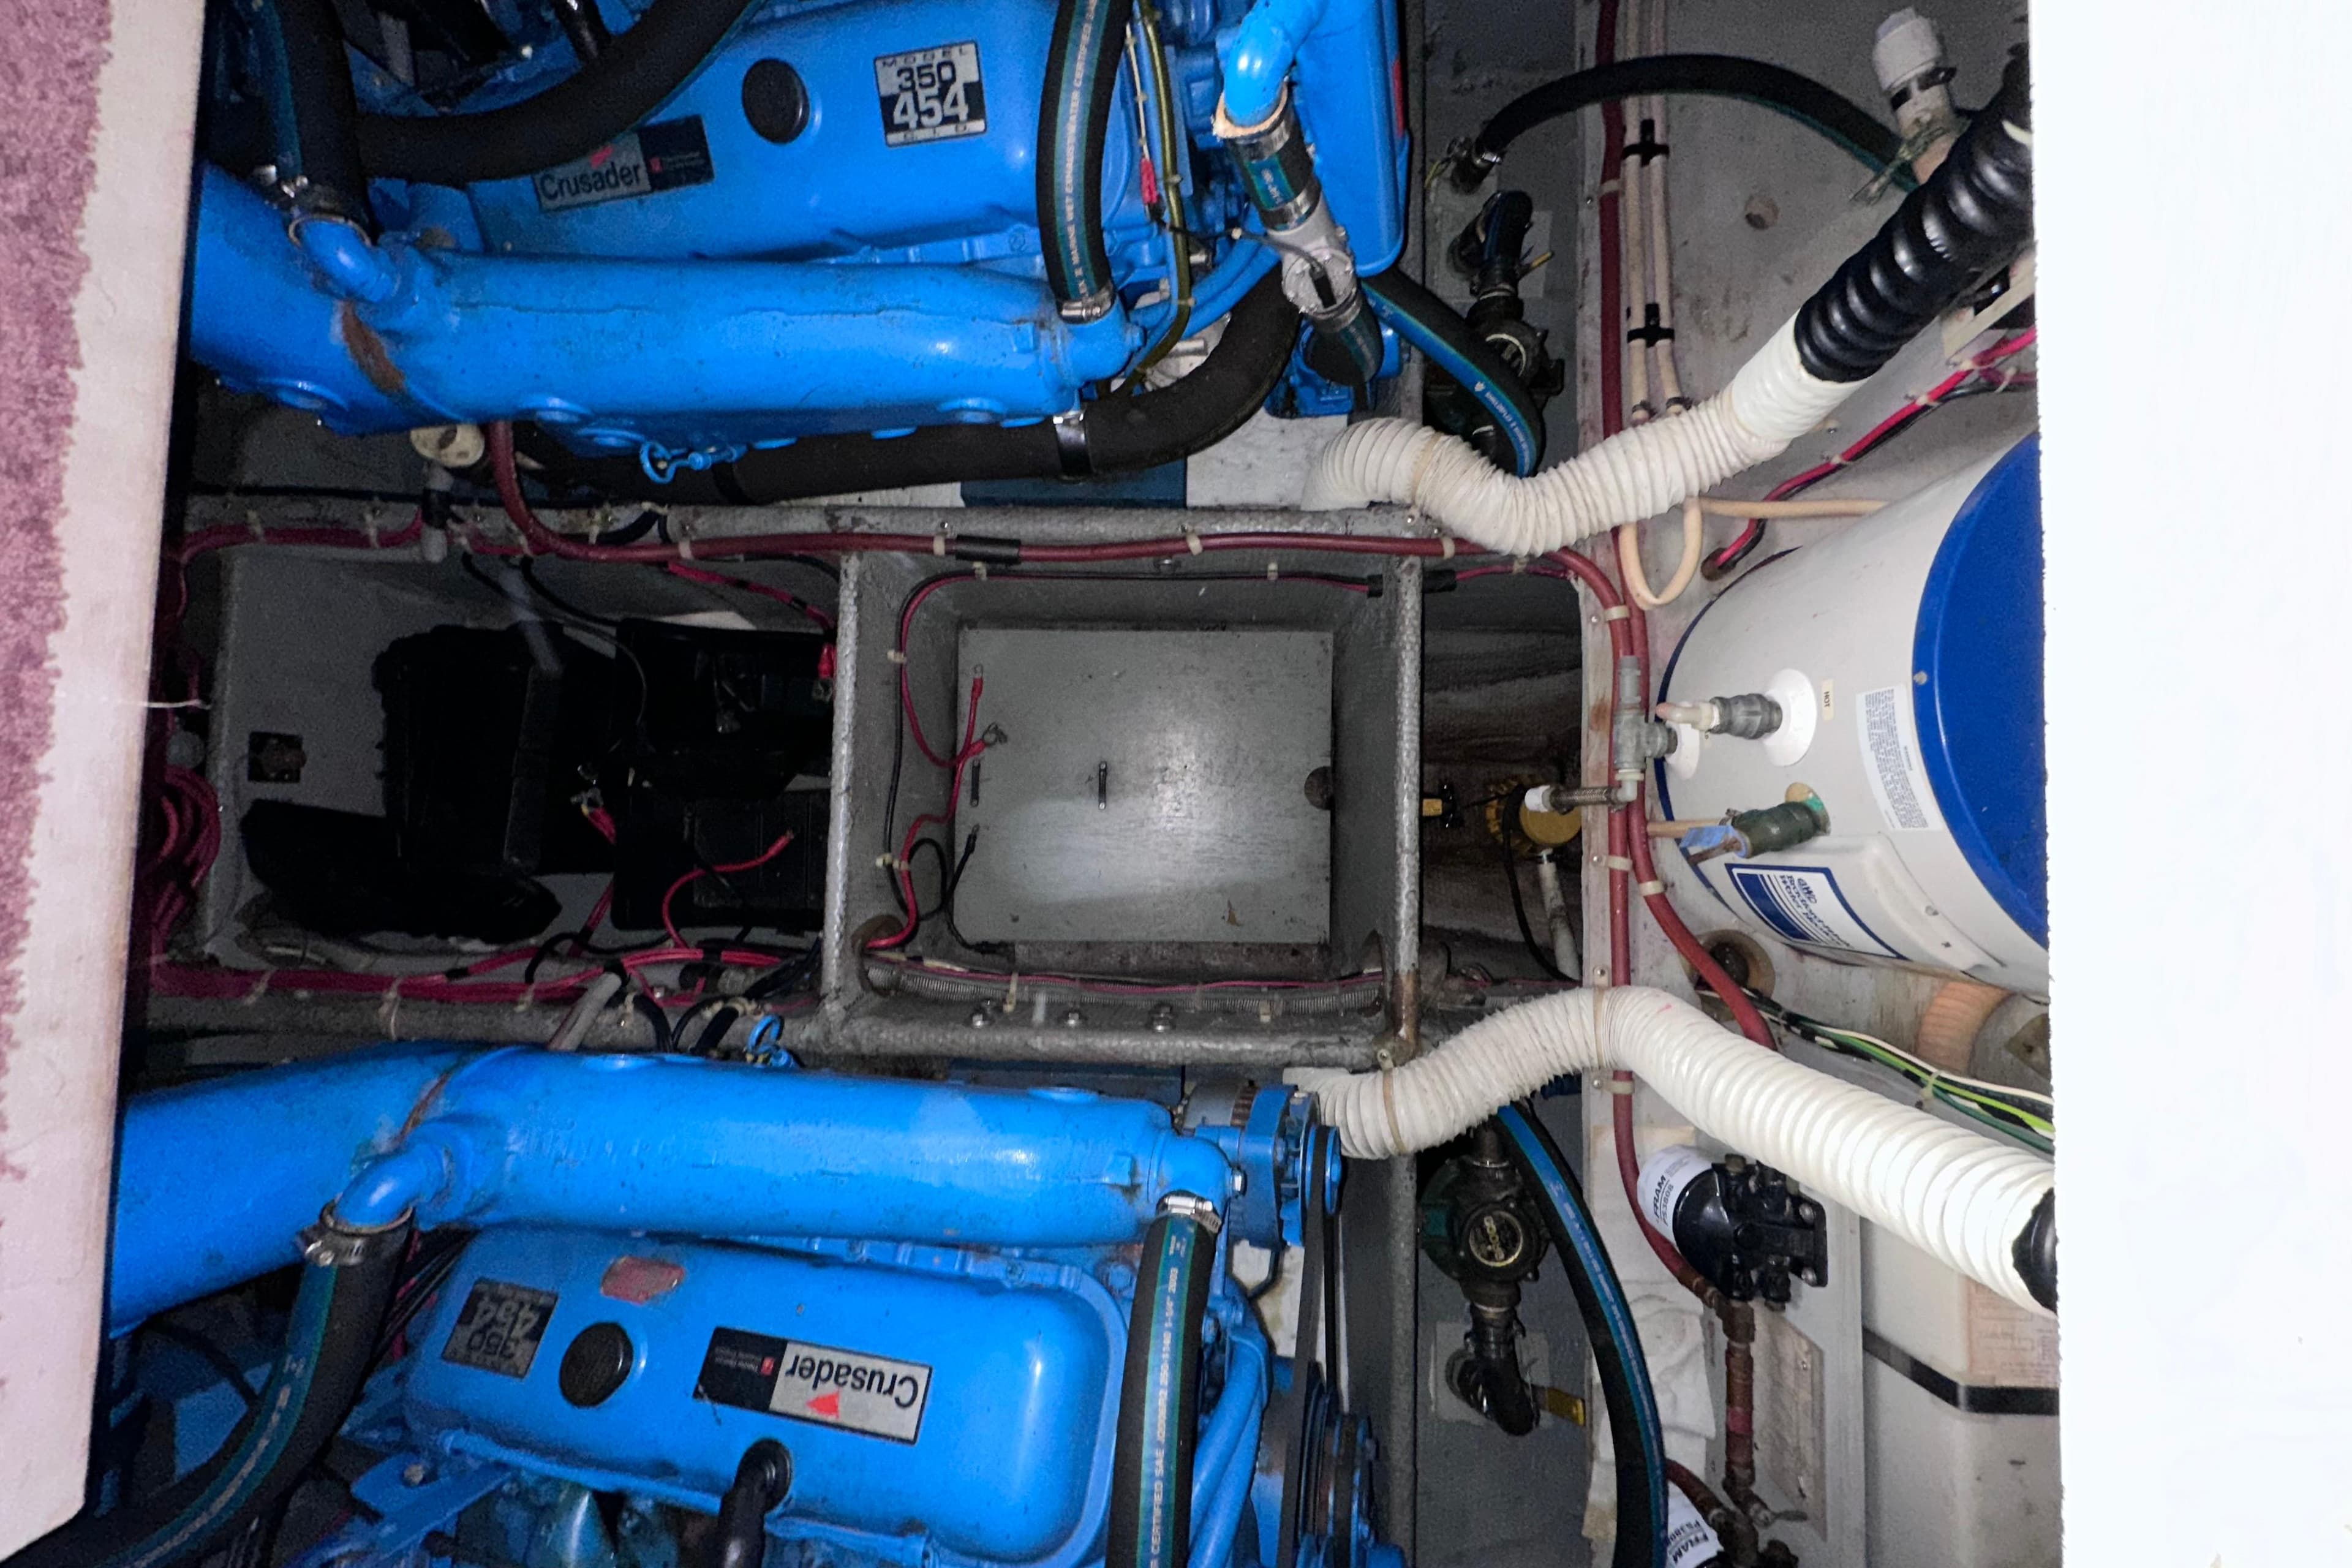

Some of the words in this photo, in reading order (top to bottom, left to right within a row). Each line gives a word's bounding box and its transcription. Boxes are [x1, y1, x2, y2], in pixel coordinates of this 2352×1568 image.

[896, 61, 957, 92] 350
[892, 80, 969, 130] 454
[540, 160, 643, 200] Crusader
[1653, 1174, 1667, 1218] FRAM
[785, 1354, 918, 1409] Crusader
[1155, 1448, 1164, 1477] SAE
[1151, 1480, 1163, 1555] CERTIFIED
[1672, 1532, 1709, 1566] FRAM
